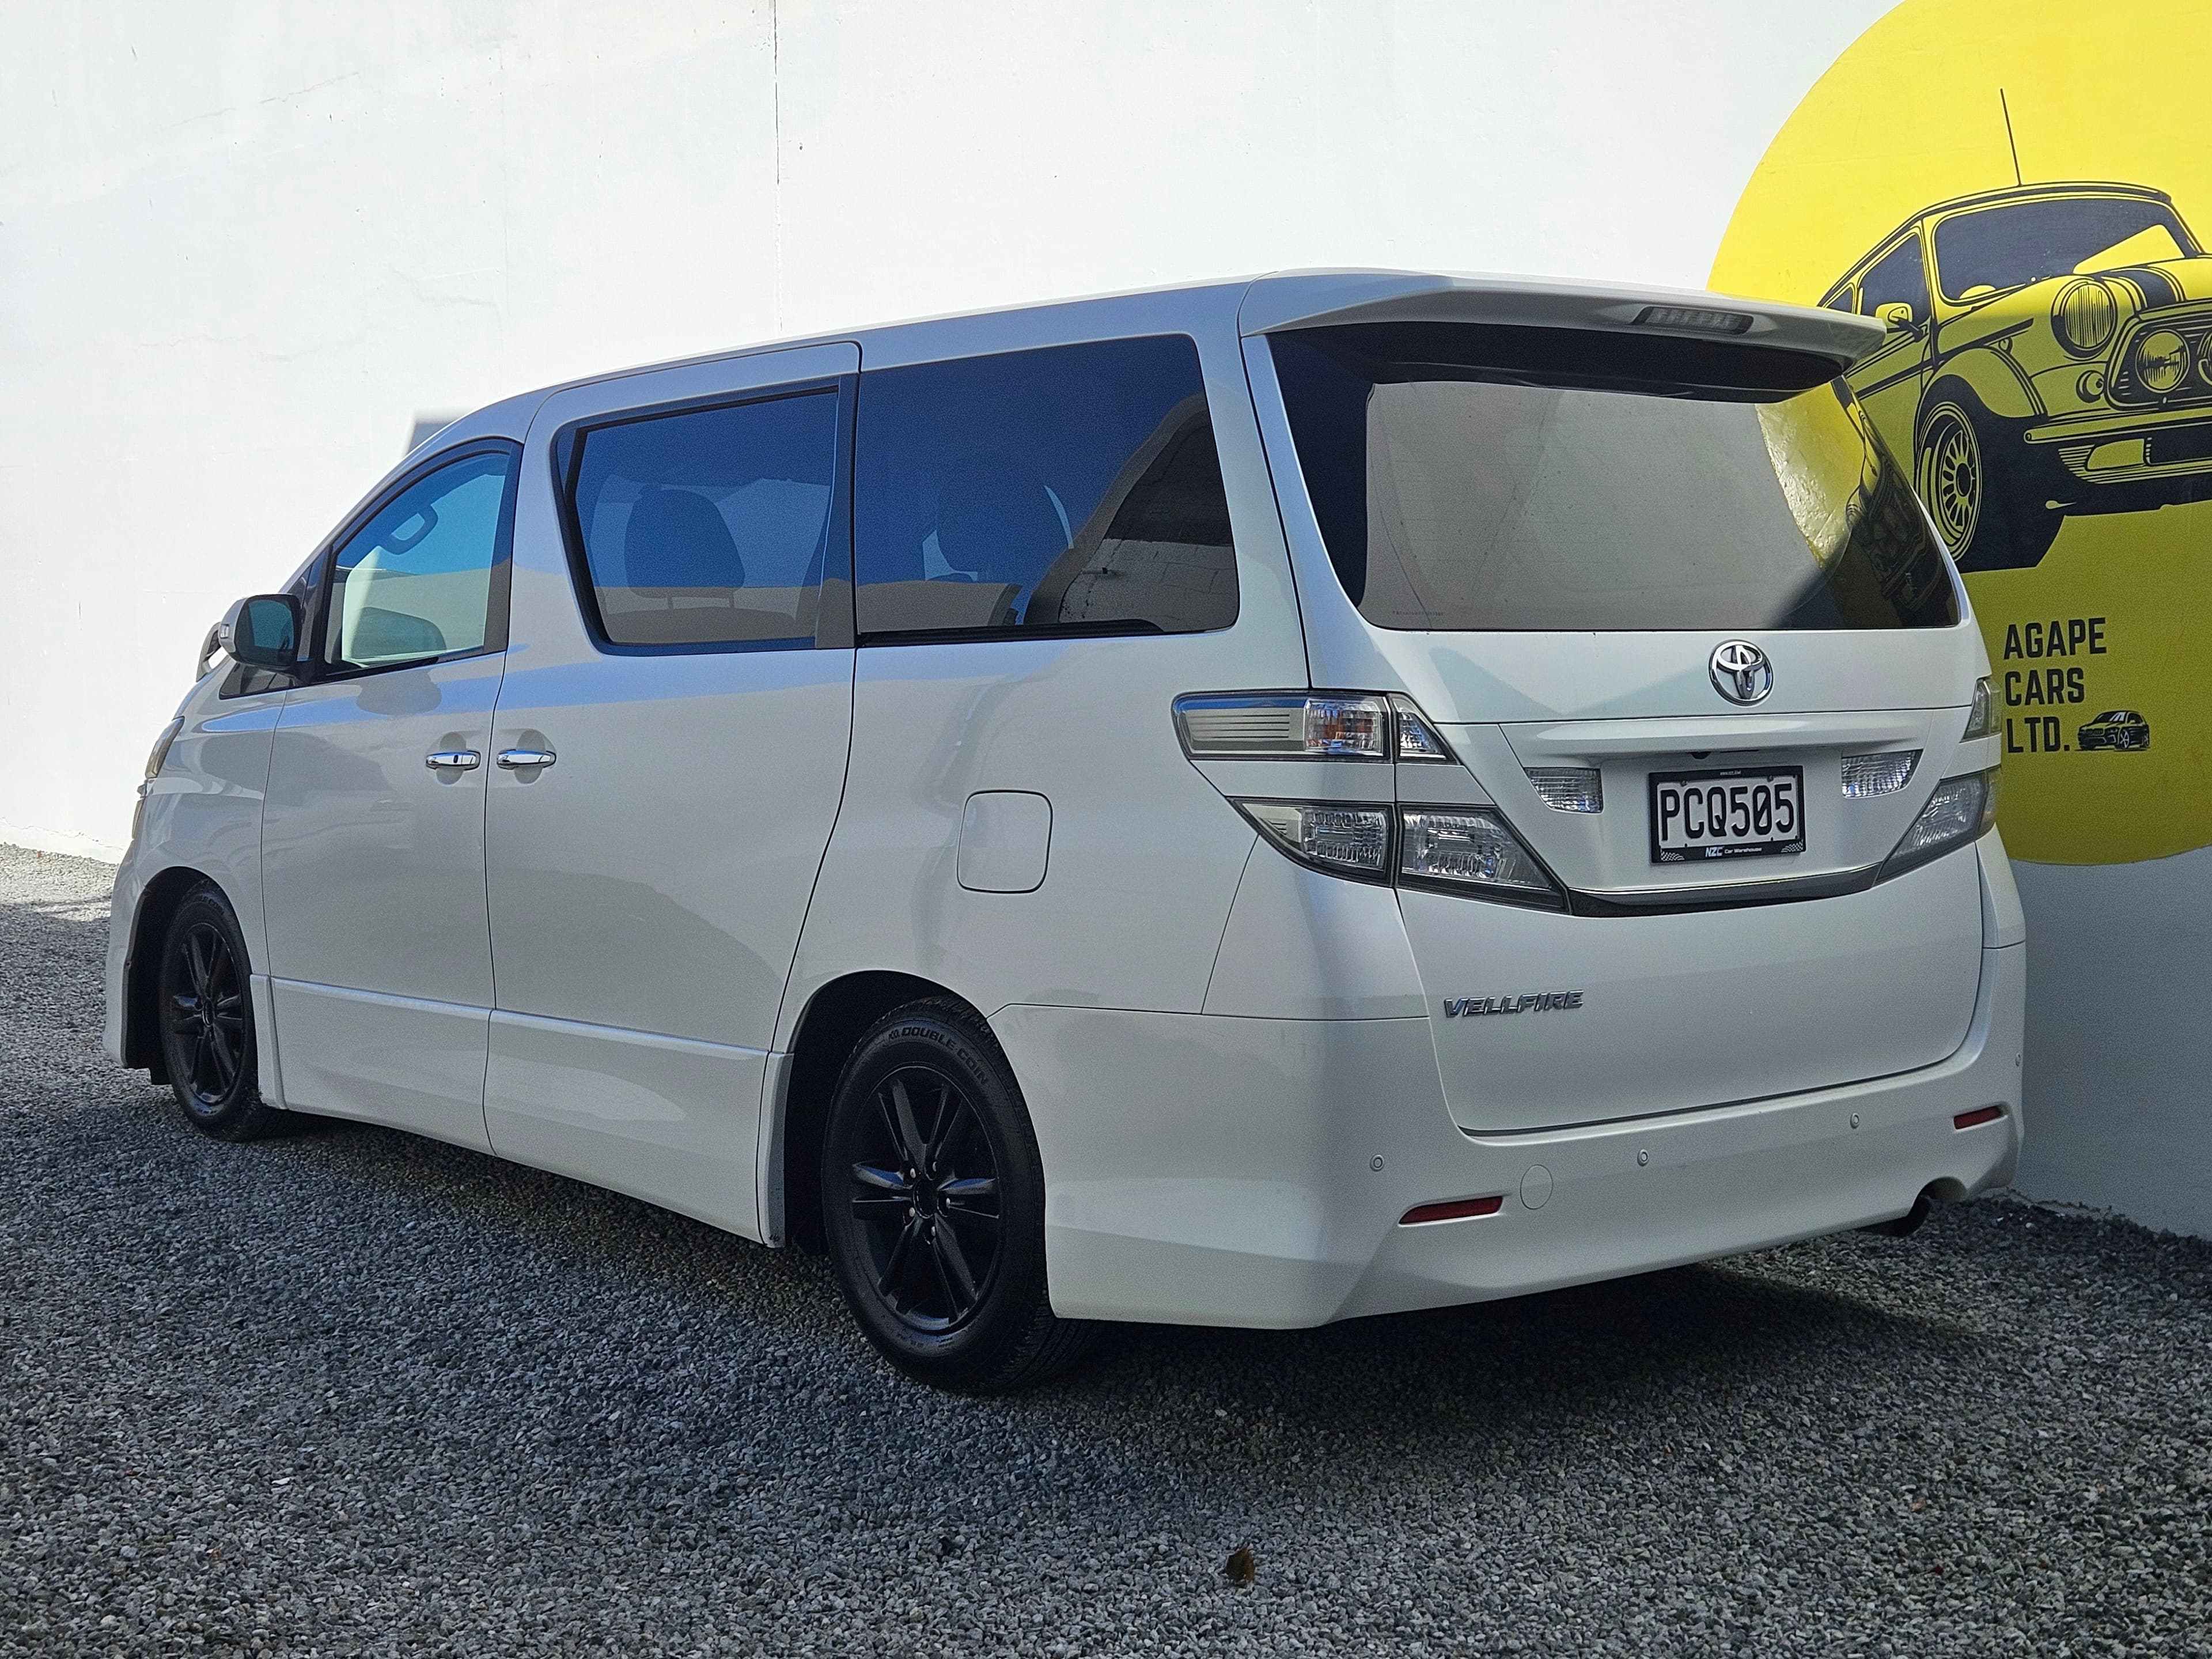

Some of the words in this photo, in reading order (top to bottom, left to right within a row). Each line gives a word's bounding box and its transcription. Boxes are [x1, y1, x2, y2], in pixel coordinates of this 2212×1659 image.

[2003, 618, 2107, 660] AGAPE
[2005, 667, 2085, 706] CARS
[2006, 716, 2070, 753] LTD.
[1660, 783, 1794, 841] PCQ505
[1705, 846, 1724, 857] NZC
[1444, 989, 1584, 1017] VELLFIRE
[902, 1027, 956, 1051] DOUBLE
[957, 1048, 990, 1085] COIN
